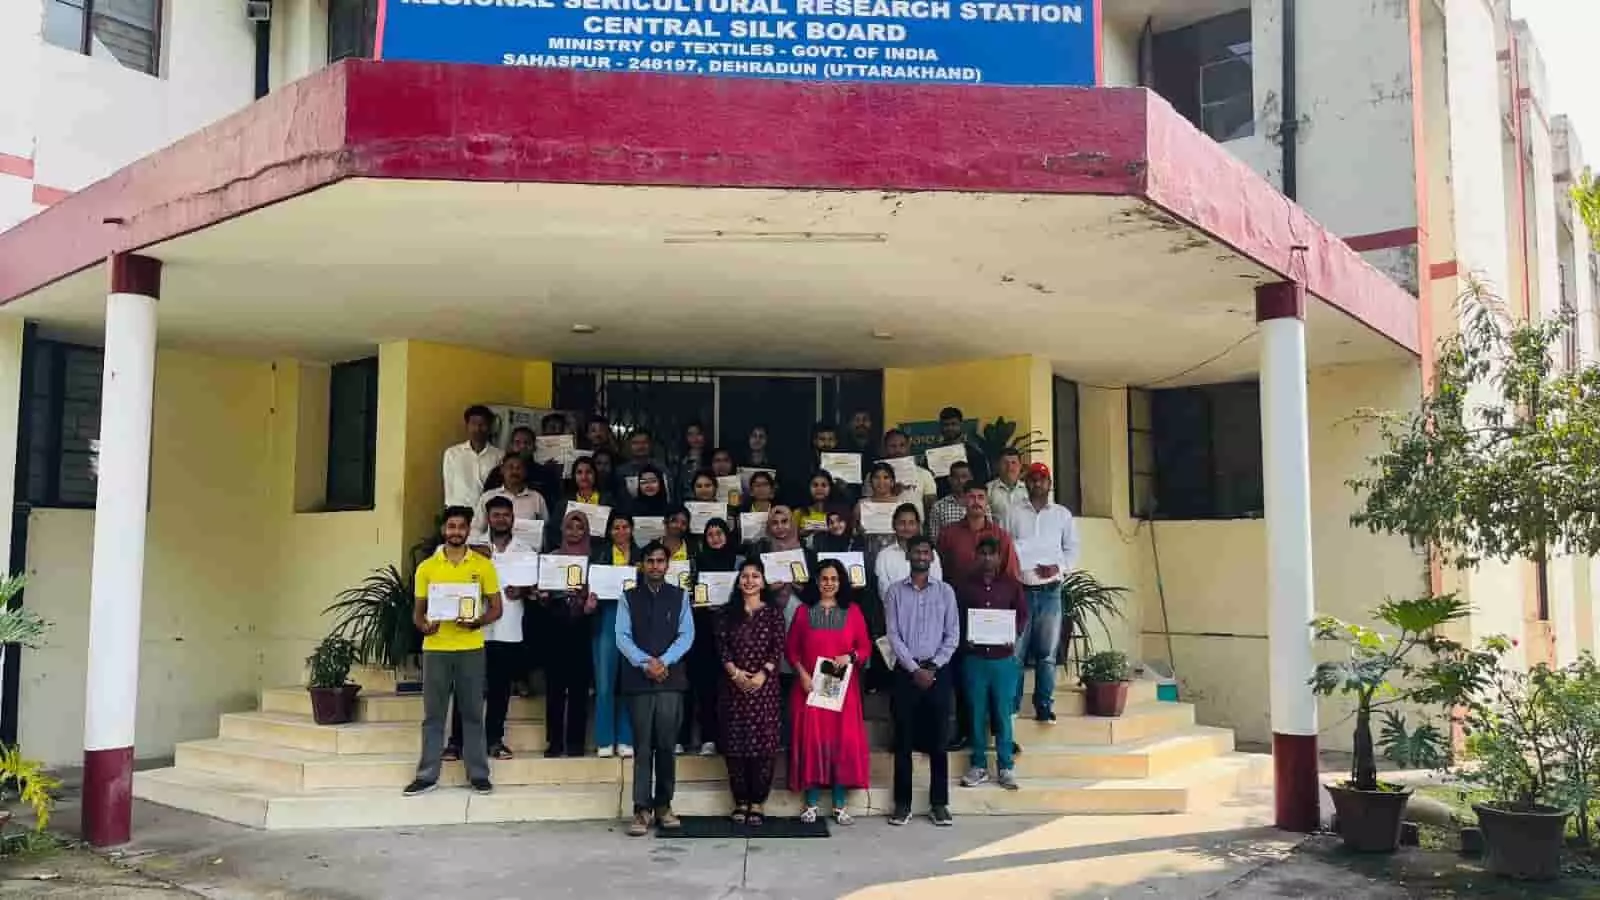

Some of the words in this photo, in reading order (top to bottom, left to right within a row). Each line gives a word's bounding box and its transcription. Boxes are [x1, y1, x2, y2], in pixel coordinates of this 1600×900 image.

[796, 0, 950, 19] RESEARCH
[959, 2, 1083, 23] STATION
[583, 15, 721, 37] CENTRAL
[729, 20, 797, 39] SILK
[806, 21, 907, 42] BOARD
[548, 37, 644, 53] MINISTRY
[649, 40, 676, 53] OF
[681, 41, 775, 57] TEXTILES
[791, 44, 848, 58] GOVT.
[853, 46, 879, 59] OF
[885, 47, 938, 61] INDIA
[503, 53, 611, 70] SAHASPUR
[628, 57, 703, 75] 248197,
[709, 59, 817, 76] DEHRADUN
[823, 63, 982, 85] (UTTARAKHAND)
